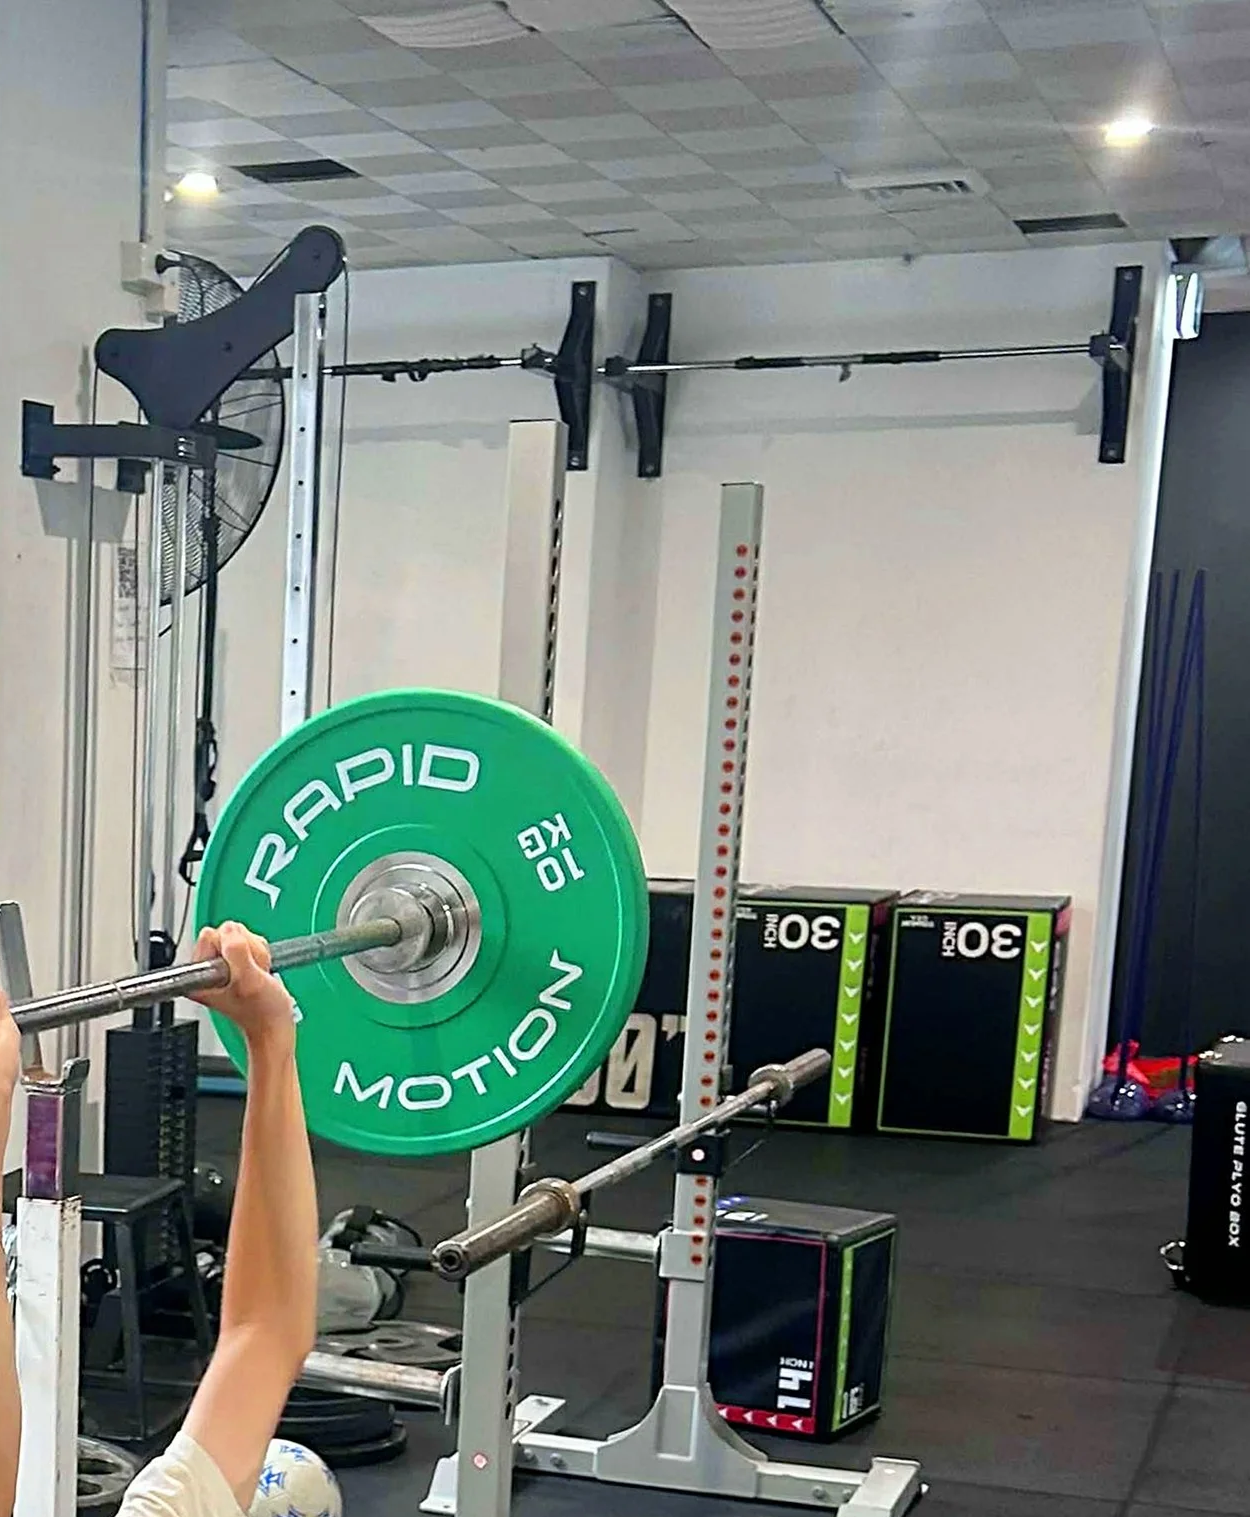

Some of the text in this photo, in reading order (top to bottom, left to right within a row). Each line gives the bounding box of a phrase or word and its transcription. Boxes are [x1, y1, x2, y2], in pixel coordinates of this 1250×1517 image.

[244, 743, 480, 908] RAPID
[517, 813, 573, 860] KG
[536, 847, 586, 892] 10
[763, 913, 779, 948] INCH
[778, 913, 841, 950] 30
[941, 921, 957, 957] INCH
[956, 921, 1022, 959] 30
[333, 949, 584, 1111] MOTION
[1228, 1101, 1248, 1248] GLUTE PLYO BOX
